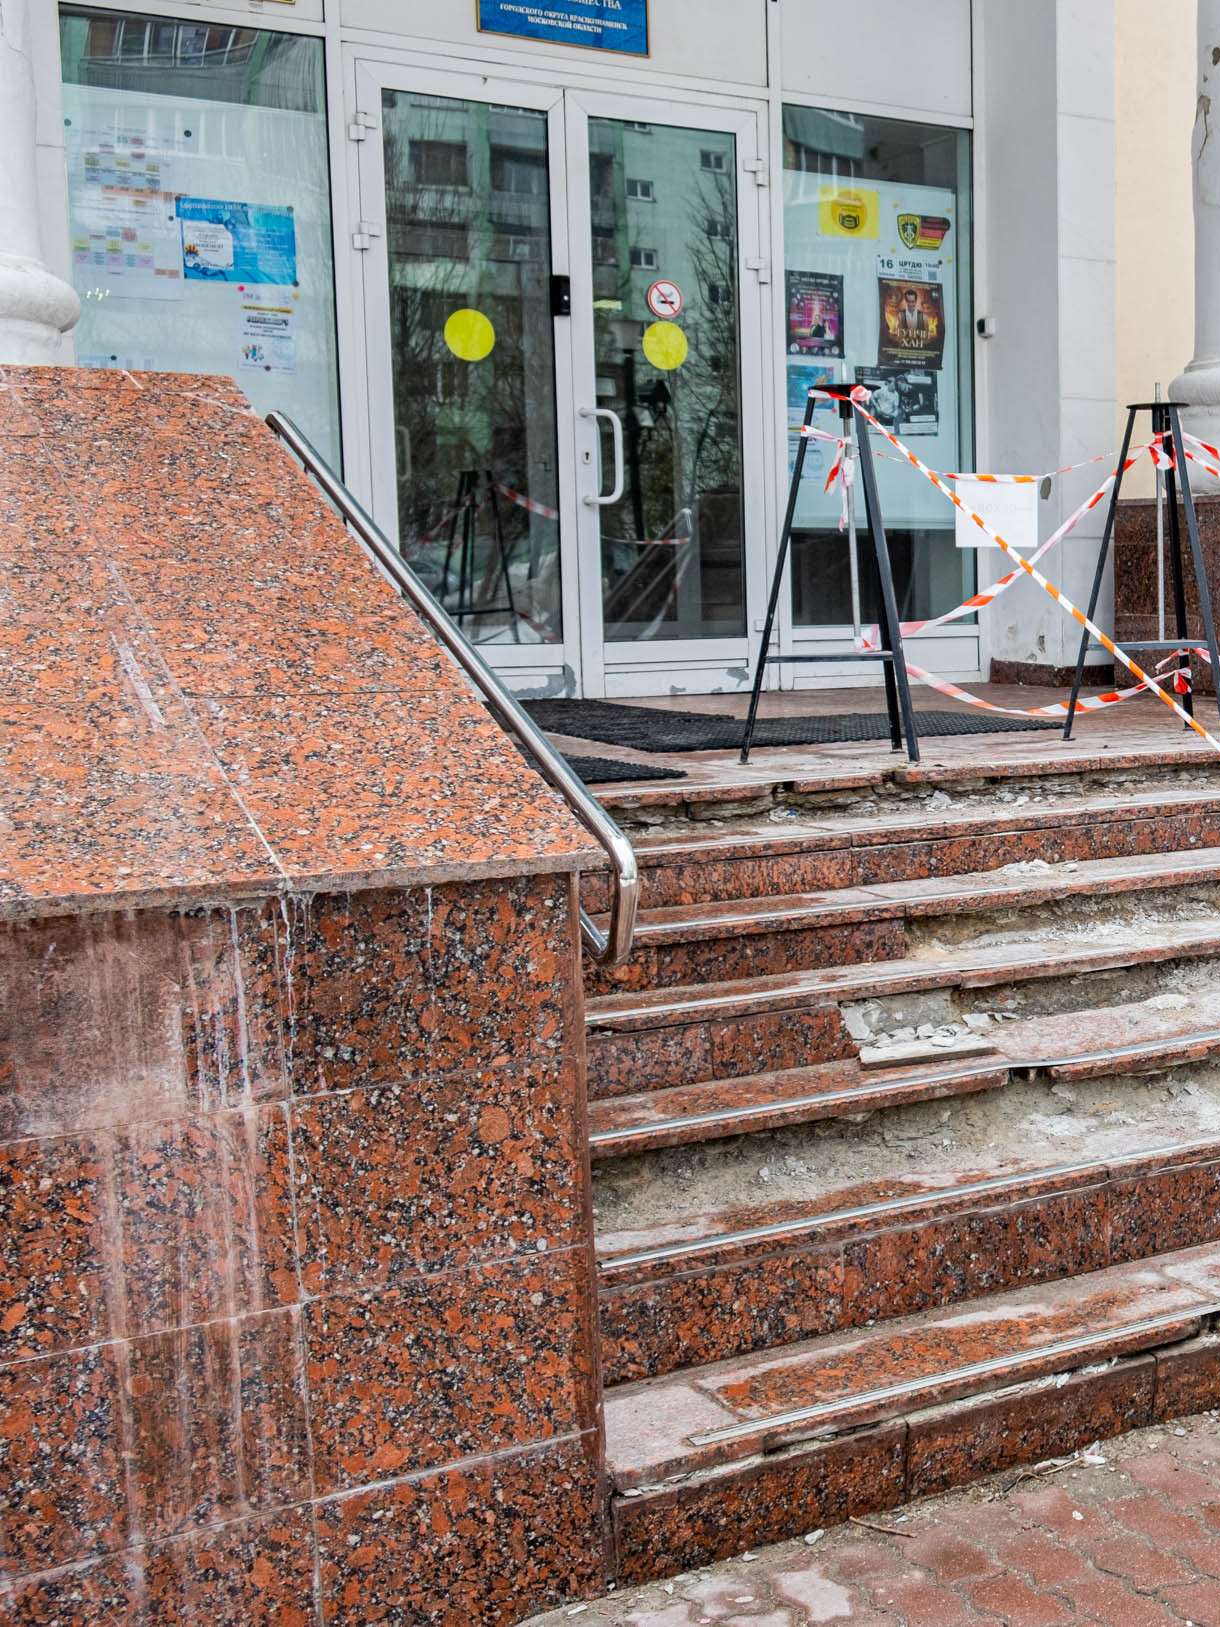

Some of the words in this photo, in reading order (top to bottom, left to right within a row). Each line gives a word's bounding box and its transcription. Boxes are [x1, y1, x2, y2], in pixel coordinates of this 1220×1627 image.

[500, 3, 543, 16] ГОРОДСКОГО
[544, 9, 569, 20] ОКРУГА
[569, 14, 628, 30] КРАСНОЗНАМЕНСК
[527, 15, 572, 29] МОСКОВСКОЙ
[572, 23, 602, 33] ОБЛАСТИ
[880, 259, 893, 269] 16
